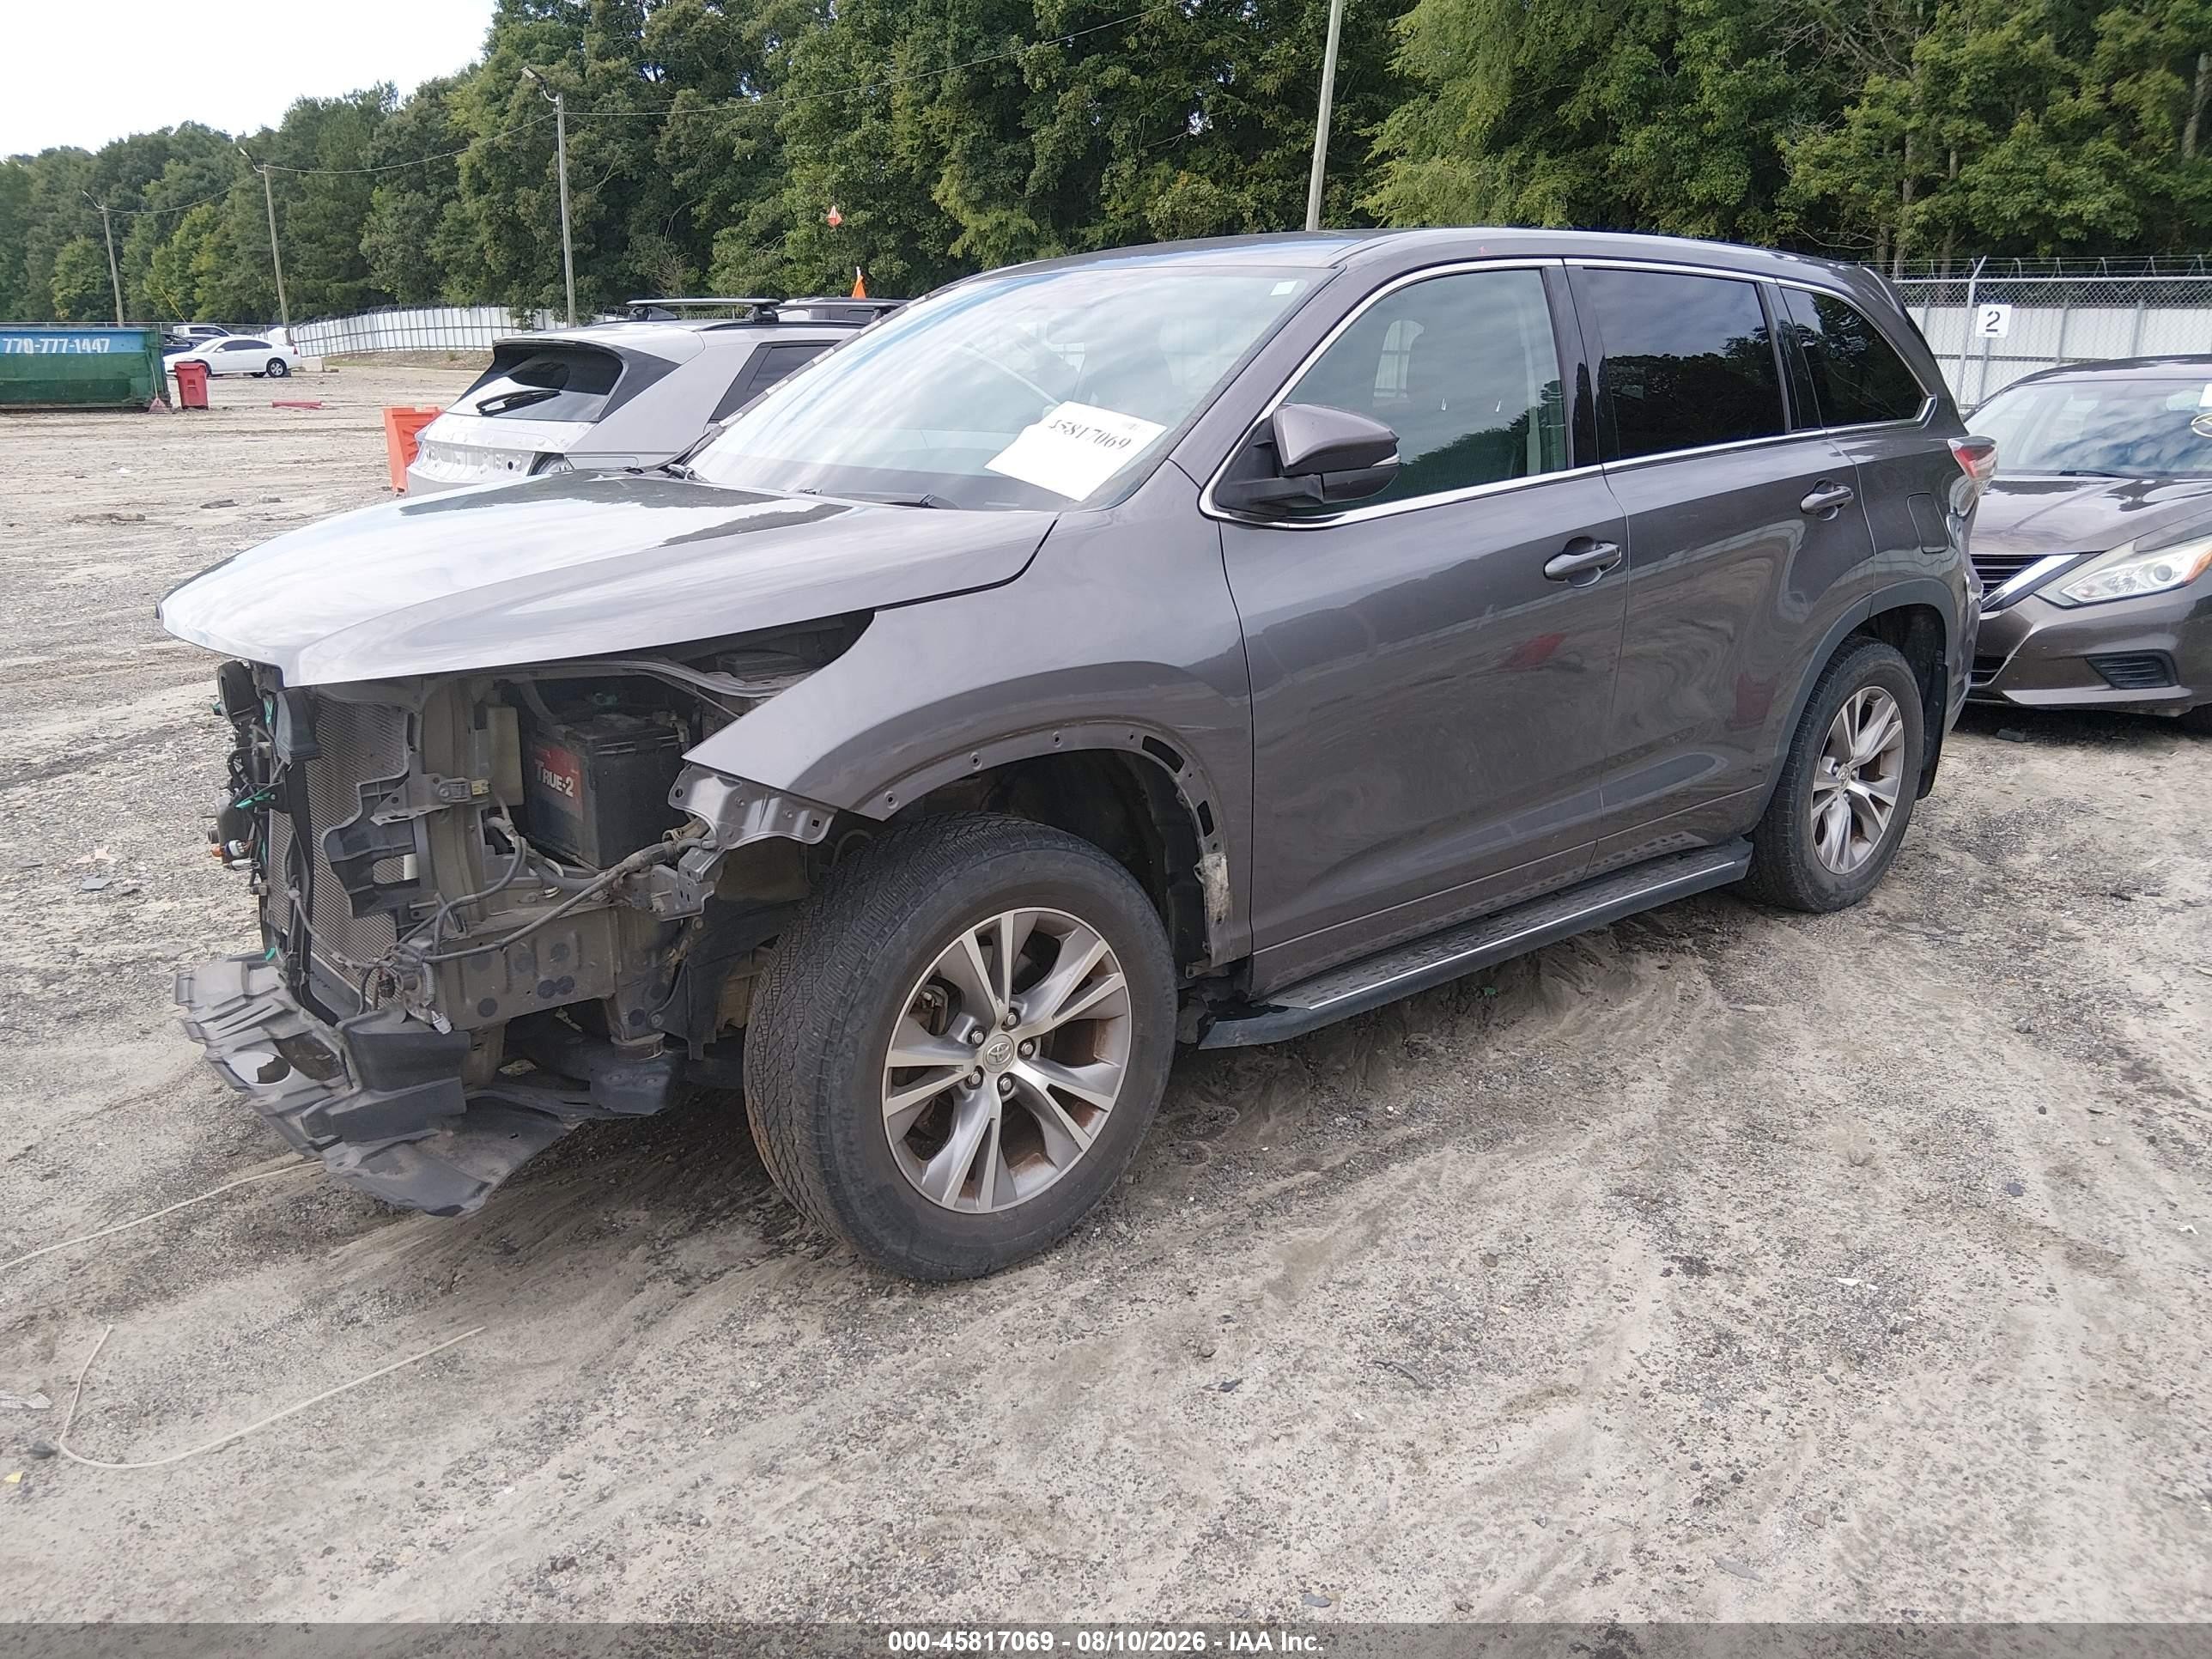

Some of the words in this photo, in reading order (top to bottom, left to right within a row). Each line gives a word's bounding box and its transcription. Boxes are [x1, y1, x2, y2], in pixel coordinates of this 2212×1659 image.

[1985, 310, 2000, 332] 2
[2, 337, 111, 354] 770-777-1447
[535, 758, 574, 798] TRUE-2
